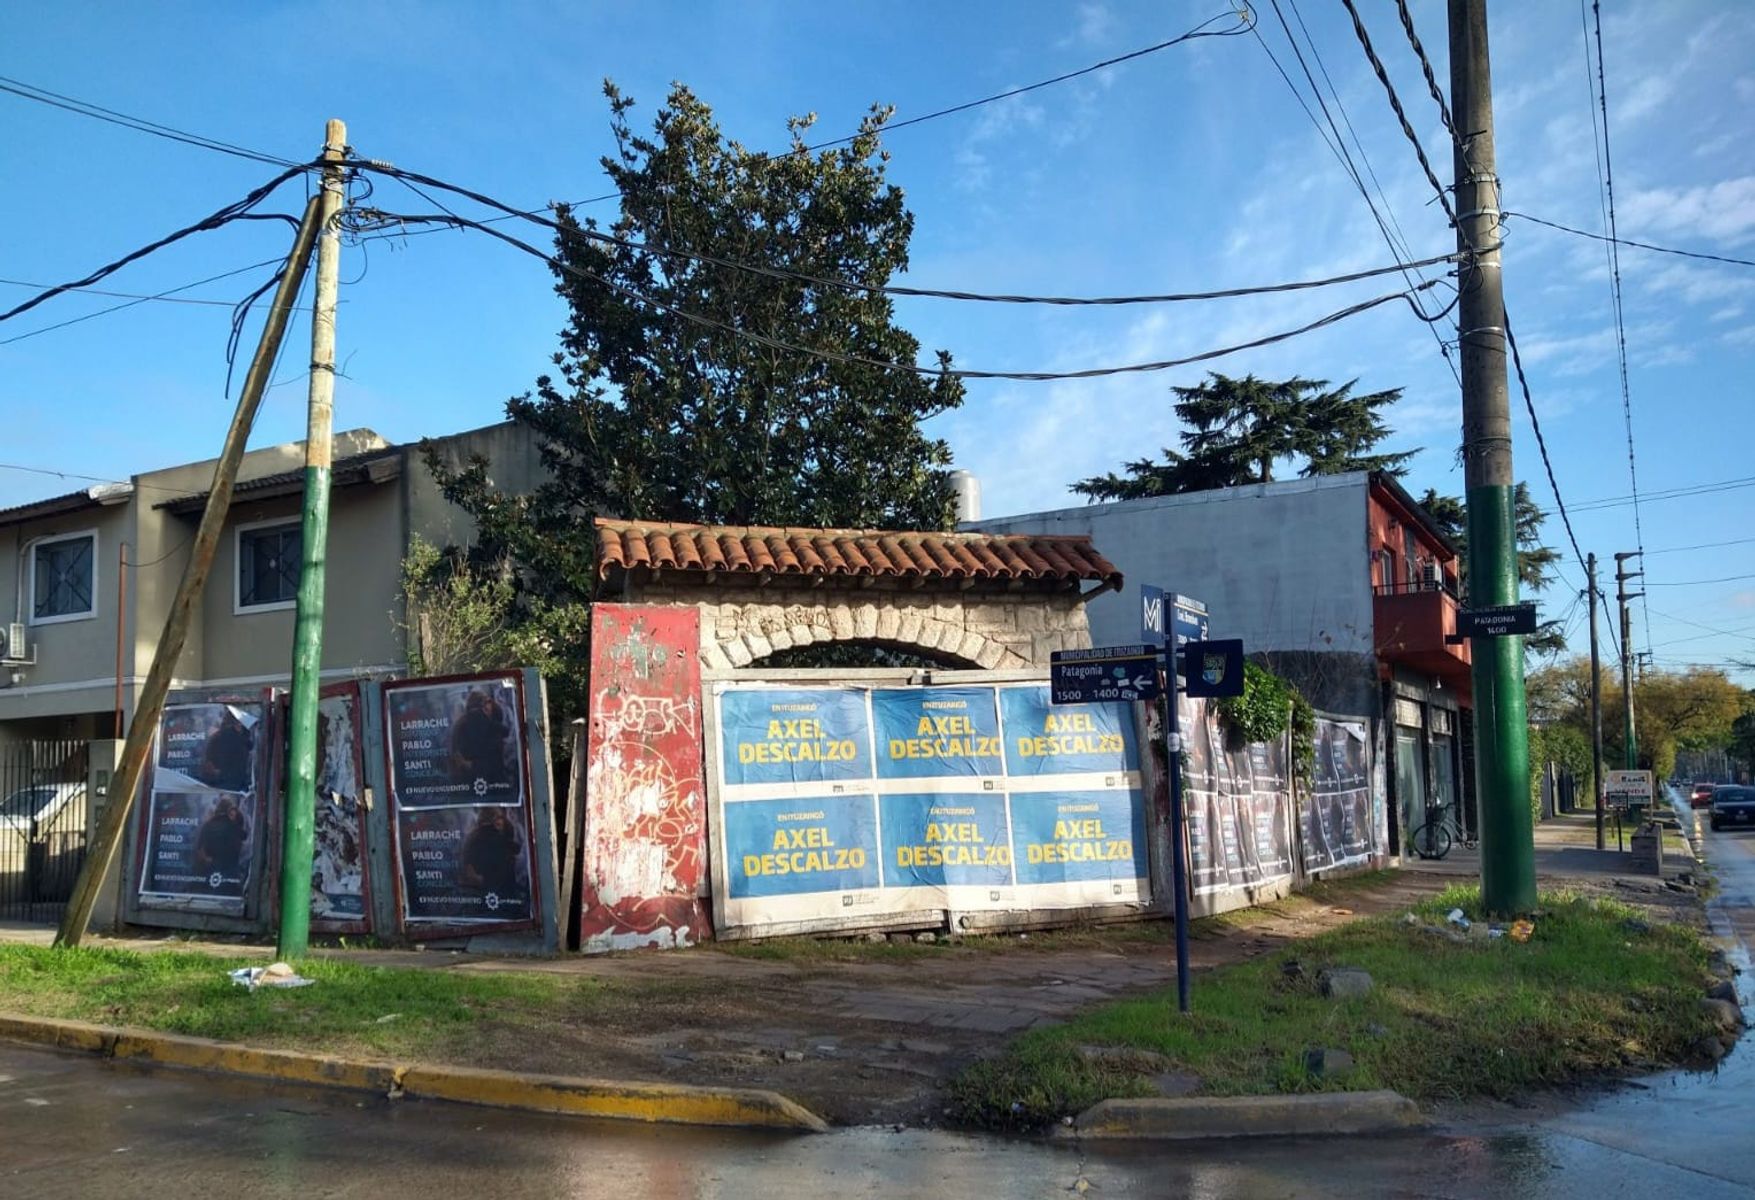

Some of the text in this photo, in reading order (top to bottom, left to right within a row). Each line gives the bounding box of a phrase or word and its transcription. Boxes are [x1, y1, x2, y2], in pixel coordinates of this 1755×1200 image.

[1474, 615, 1516, 624] PATAGONIA
[1487, 626, 1507, 634] 1400
[1061, 663, 1103, 679] Patagonia
[1057, 690, 1082, 701] 1500
[1093, 688, 1119, 699] 1400
[400, 717, 449, 730] LARRACHE
[767, 719, 827, 739] AXEL
[917, 716, 976, 737] AXEL
[1044, 713, 1097, 733] AXEL
[168, 731, 205, 741] LARRACHE
[402, 740, 432, 750] PABLO
[1017, 733, 1124, 757] DESCALZO
[167, 750, 191, 759] PABLO
[739, 740, 857, 764] DESCALZO
[404, 760, 432, 770] SANTI
[161, 817, 199, 826] LARRACHE
[411, 830, 461, 840] LARRACHE
[926, 823, 984, 843] AXEL
[1054, 819, 1106, 840] AXEL
[160, 834, 184, 843] PABLO
[773, 828, 834, 850] AXEL
[158, 851, 180, 860] SANTI
[412, 851, 444, 860] PABLO
[1027, 841, 1132, 865] DESCALZO
[743, 848, 865, 877] DESCALZO
[416, 870, 442, 880] SANTI
